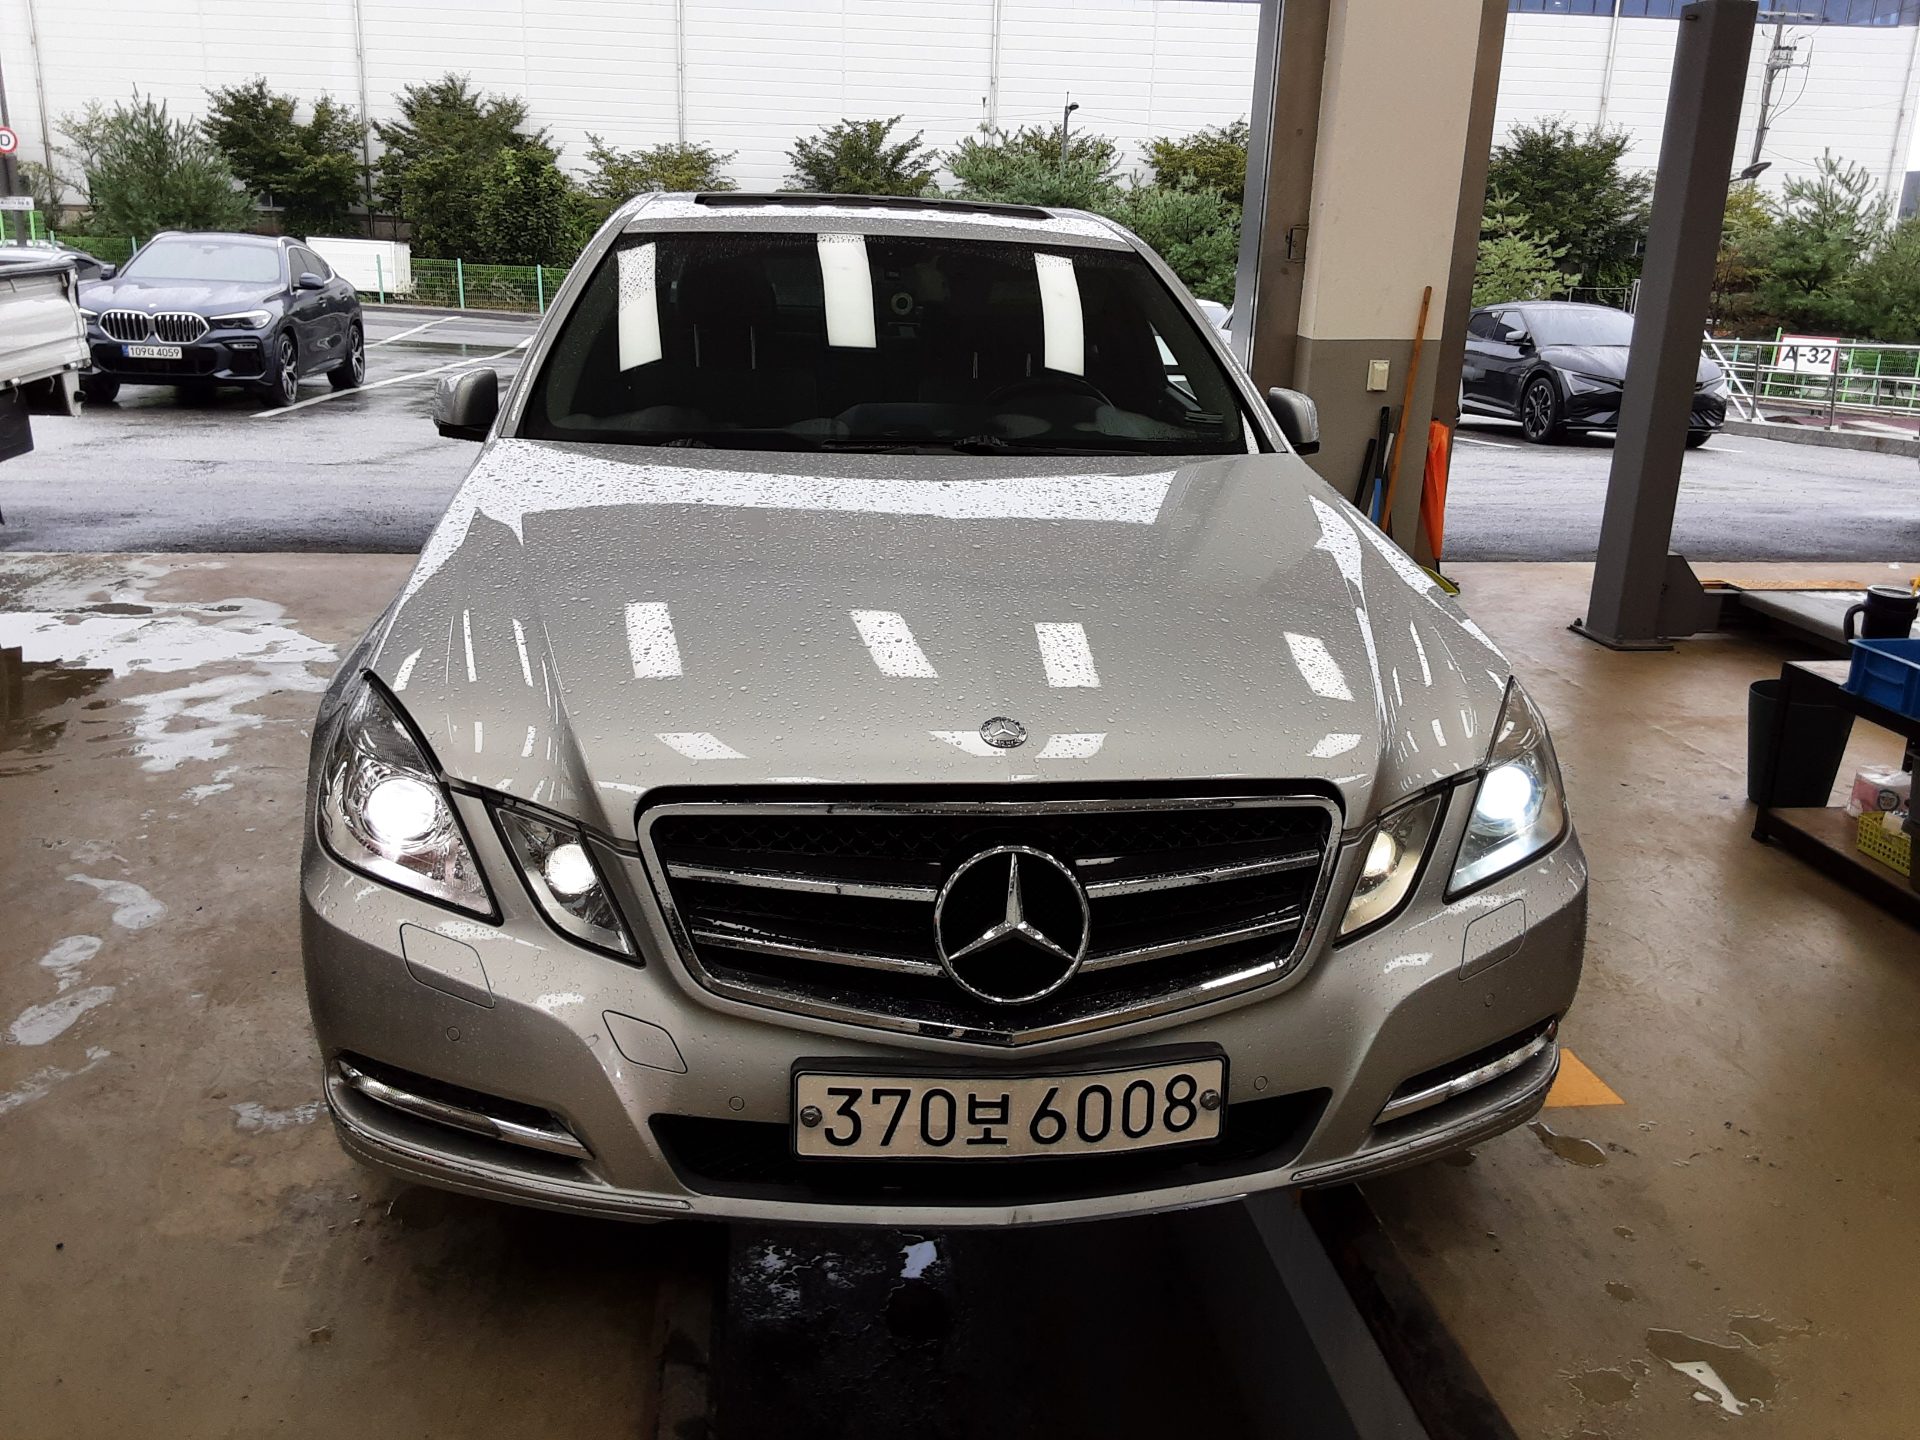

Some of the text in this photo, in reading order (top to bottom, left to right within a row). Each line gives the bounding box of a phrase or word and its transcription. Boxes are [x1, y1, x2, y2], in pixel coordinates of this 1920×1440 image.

[156, 347, 180, 357] 4059
[1782, 346, 1832, 364] A-32
[823, 1072, 1199, 1148] 370보 6008
